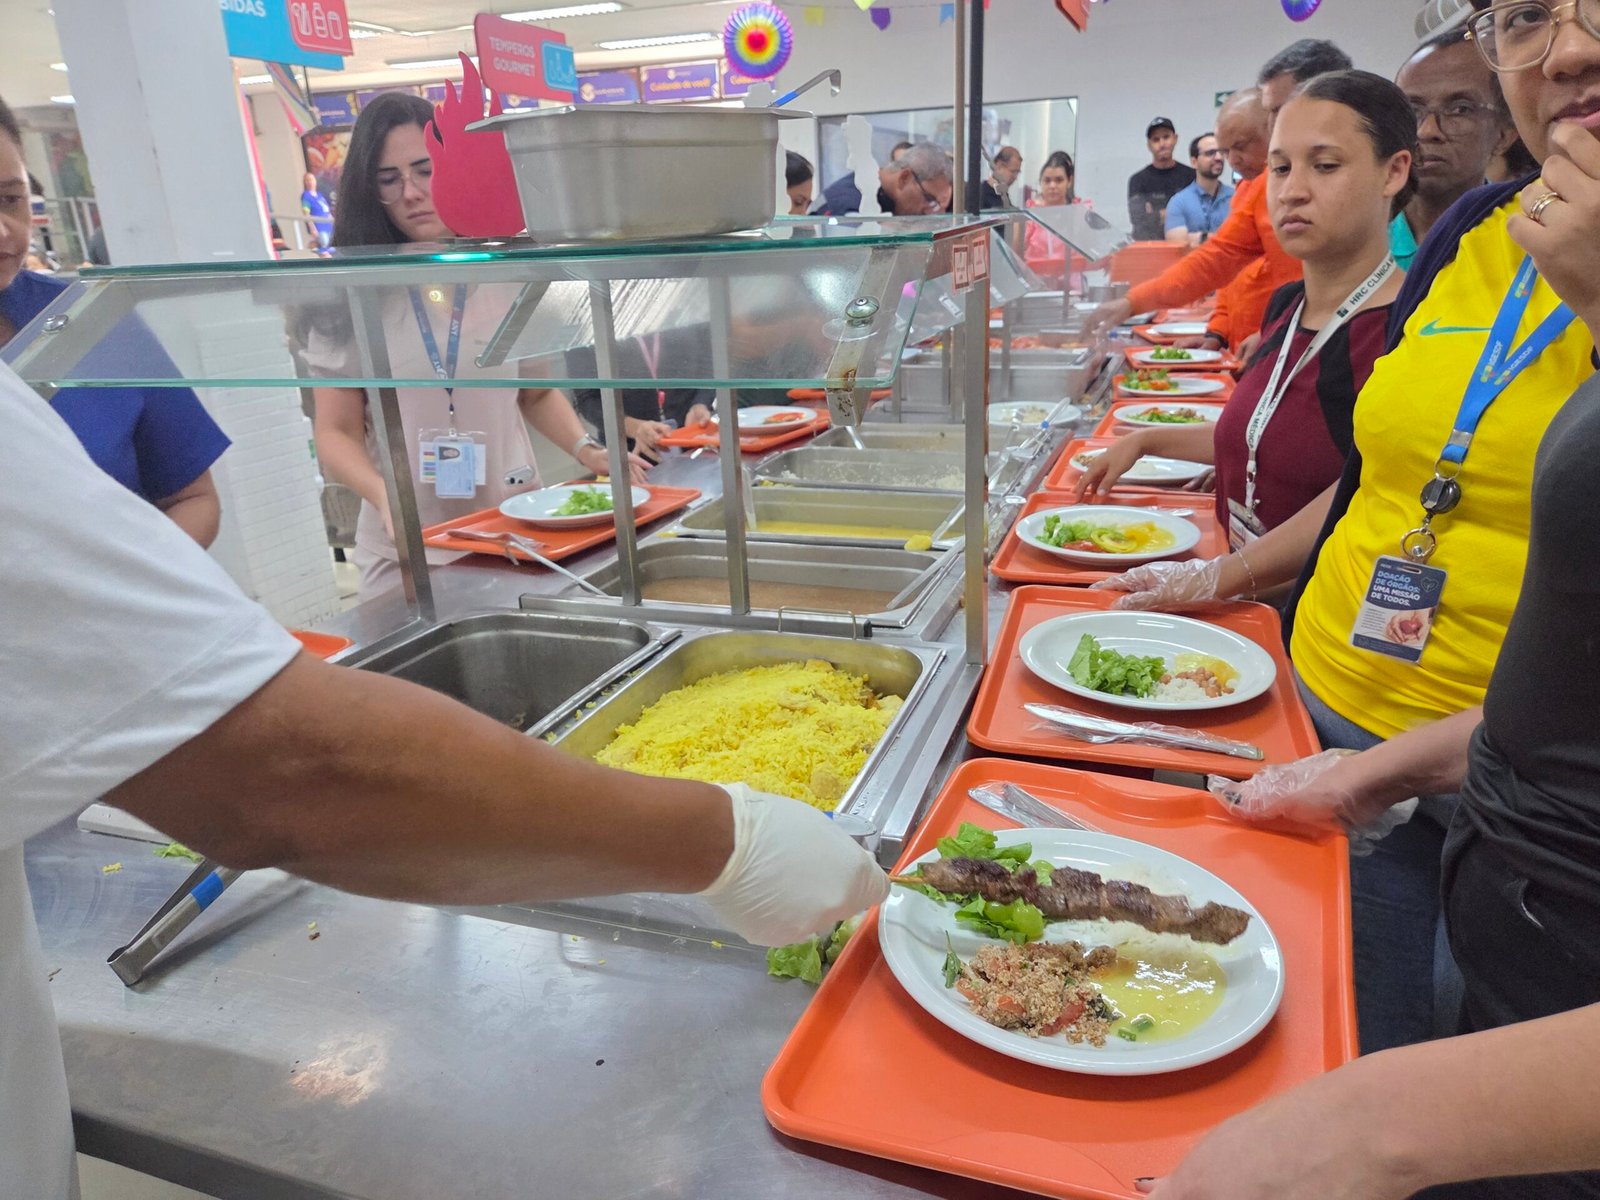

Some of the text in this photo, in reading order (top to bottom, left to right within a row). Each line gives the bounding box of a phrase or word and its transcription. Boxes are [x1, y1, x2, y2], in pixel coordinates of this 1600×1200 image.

[489, 36, 535, 58] TEMPEROS
[493, 57, 535, 77] GOURMET
[1349, 261, 1391, 305] HRC CLÍNICA
[1377, 570, 1411, 583] DOAÇÃO
[1371, 591, 1382, 600] DE
[1373, 584, 1420, 601] UMA MISSÃO
